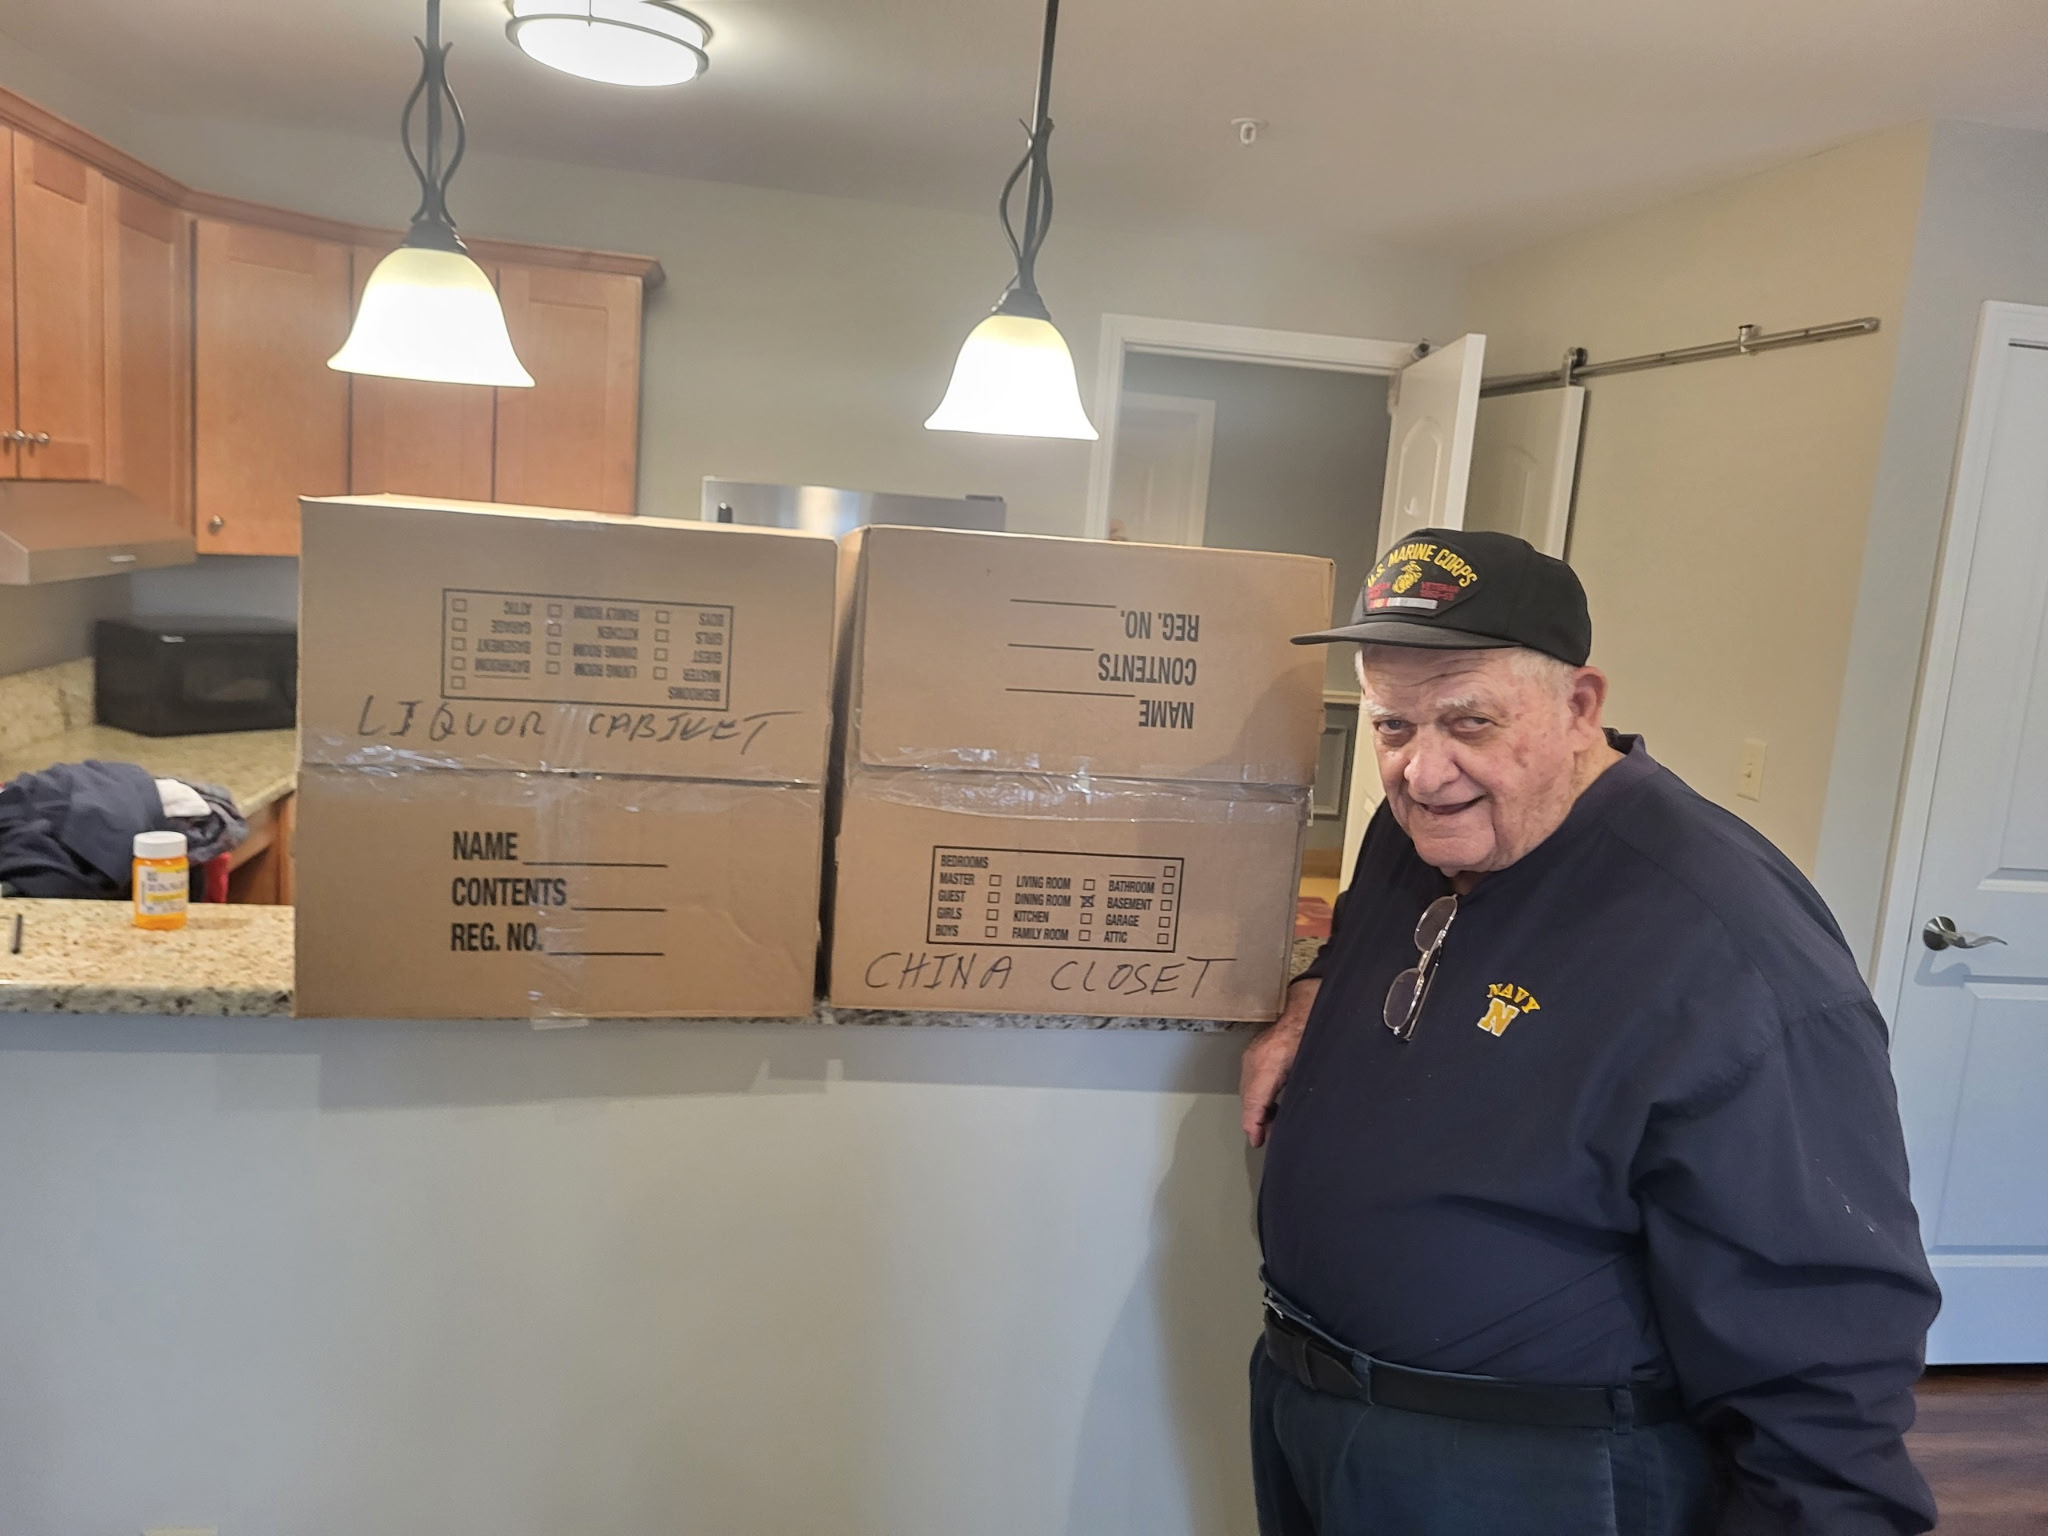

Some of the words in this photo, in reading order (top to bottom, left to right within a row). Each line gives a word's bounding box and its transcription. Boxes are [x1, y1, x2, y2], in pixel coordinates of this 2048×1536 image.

[1388, 543, 1438, 568] MARINE
[1433, 548, 1478, 588] CORPS
[1120, 610, 1152, 640] NO.
[1157, 612, 1200, 642] REG.
[1098, 653, 1197, 686] CONTENTS
[1138, 699, 1194, 729] NAME
[357, 695, 545, 742] LIQUOR
[588, 711, 803, 755] CABINET
[452, 831, 518, 861] NAME
[940, 854, 989, 869] BEDROOMS
[939, 872, 975, 886] MASTER
[1016, 875, 1043, 889] LIVING
[1045, 876, 1071, 890] ROOM
[1108, 879, 1155, 893] BATHROOM
[451, 877, 567, 906] CONTENTS
[938, 889, 966, 903] GUEST
[1014, 892, 1043, 906] DINING
[1044, 894, 1071, 907] ROOM
[1106, 897, 1152, 911] BASEMENT
[936, 907, 962, 920] GIRLS
[1013, 910, 1049, 923] KITCHEN
[1105, 914, 1139, 927] GARAGE
[451, 922, 501, 951] REG.
[507, 922, 544, 951] NO.
[935, 924, 959, 937] BOYS
[1012, 926, 1041, 941] FAMILY
[1043, 928, 1069, 941] ROOM
[1104, 931, 1128, 944] ATTIC
[865, 952, 1012, 990] CHINA
[1050, 956, 1237, 999] CLOSET
[1486, 983, 1541, 1014] NAVY
[1477, 997, 1520, 1037] N
